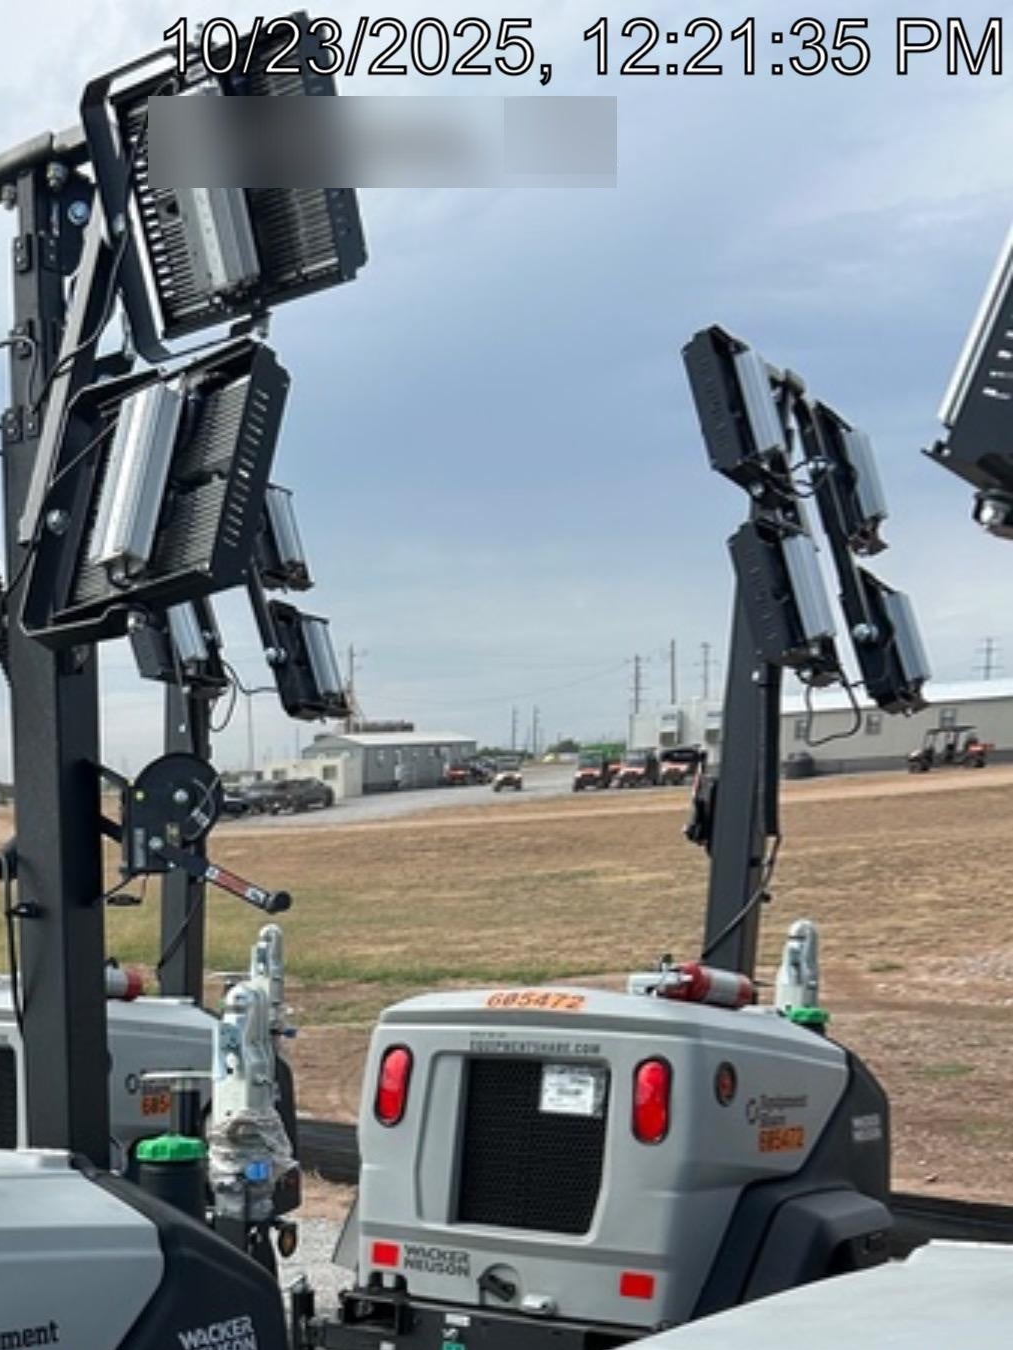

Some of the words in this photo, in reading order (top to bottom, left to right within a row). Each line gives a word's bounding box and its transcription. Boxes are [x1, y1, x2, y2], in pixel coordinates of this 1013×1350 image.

[404, 1244, 470, 1262] WACKER
[404, 1257, 470, 1278] NEUSON
[178, 1315, 255, 1350] WACKER
